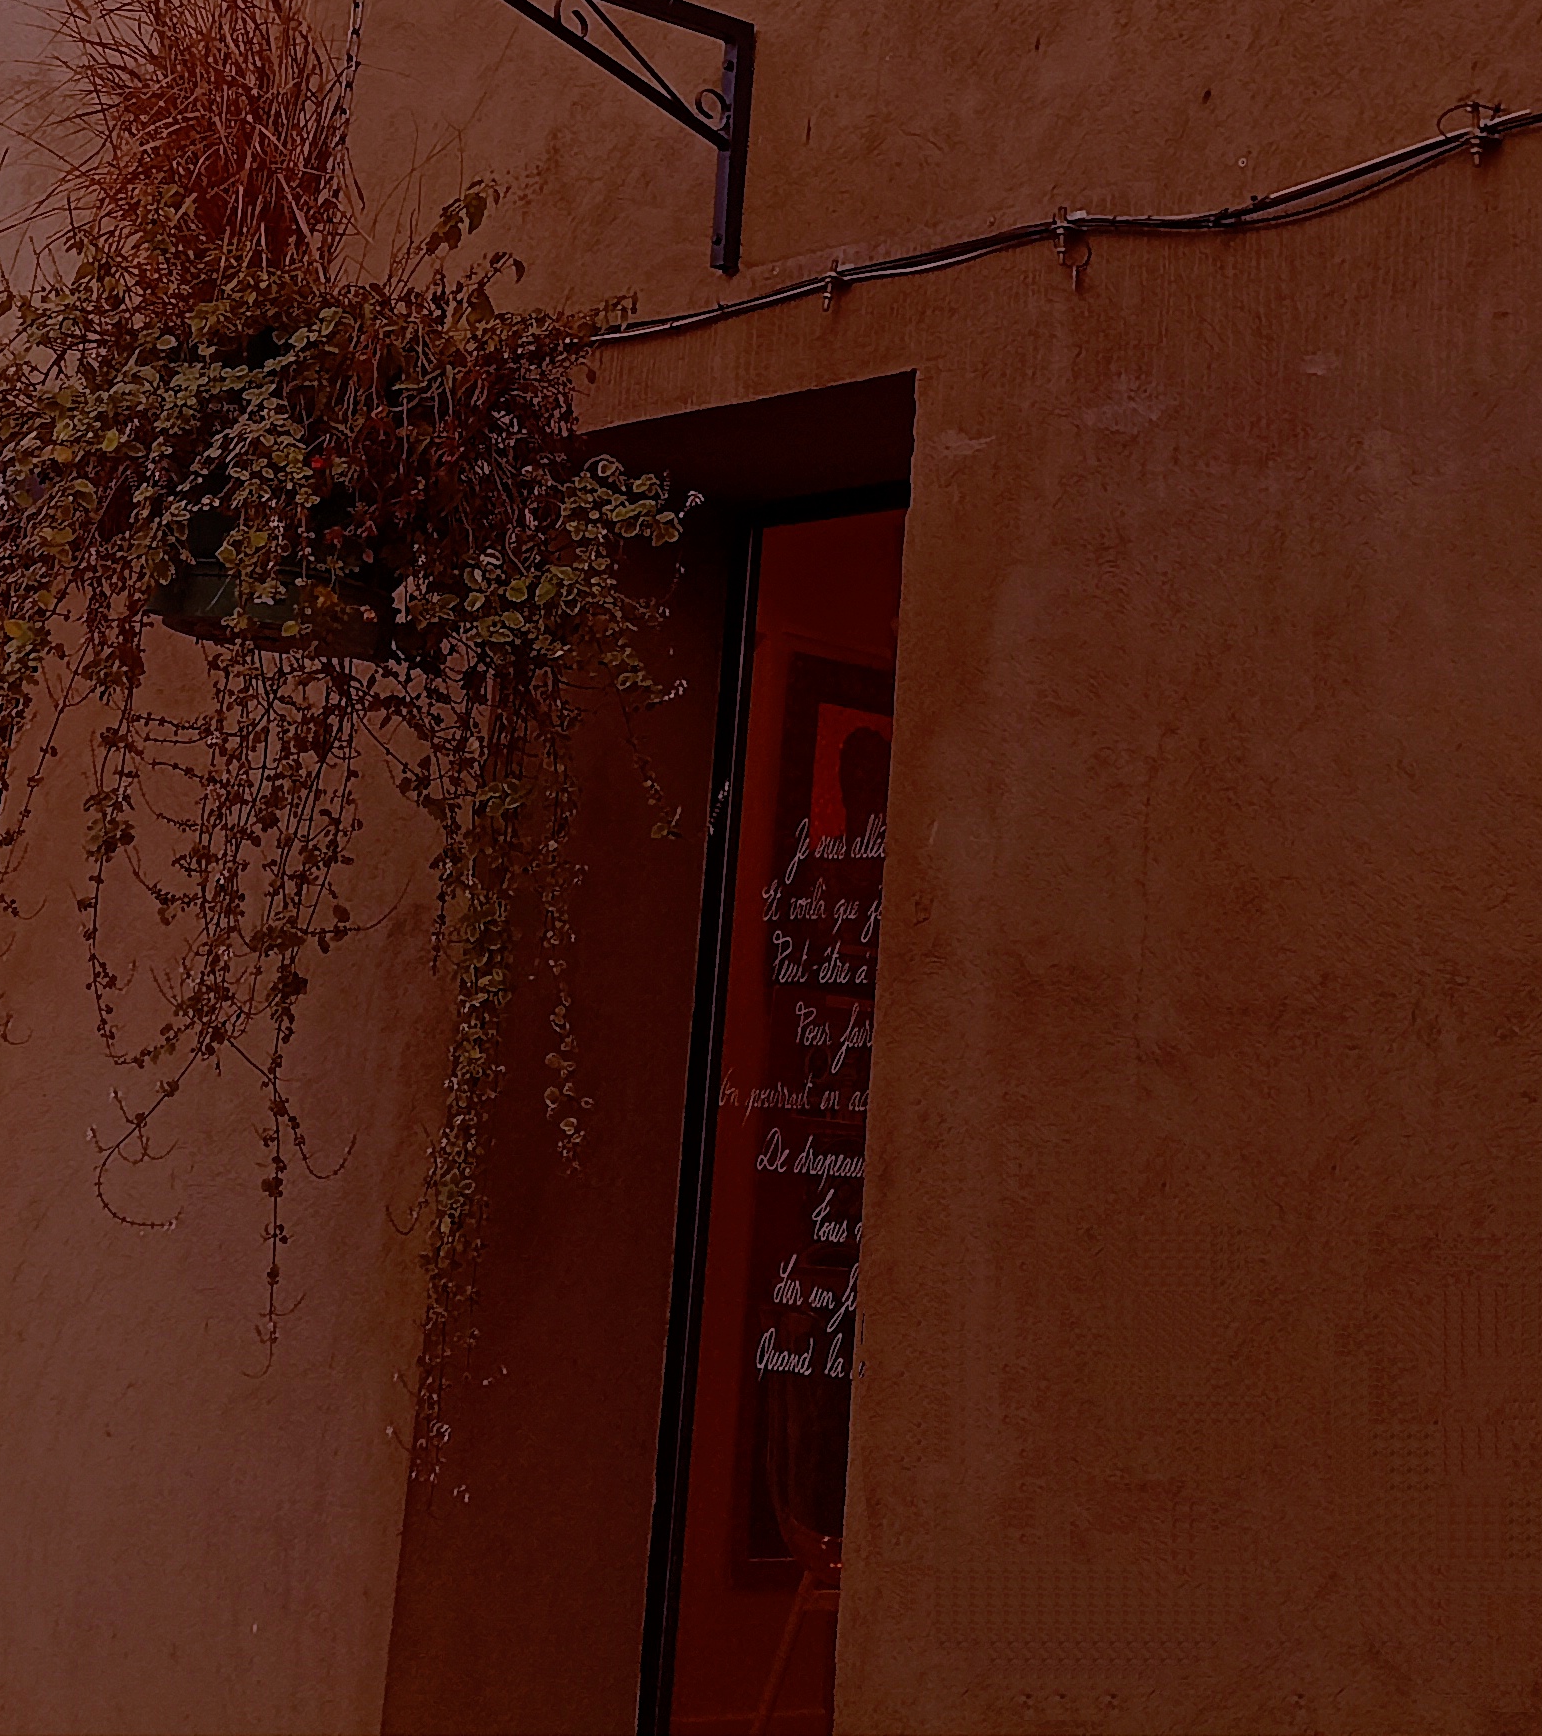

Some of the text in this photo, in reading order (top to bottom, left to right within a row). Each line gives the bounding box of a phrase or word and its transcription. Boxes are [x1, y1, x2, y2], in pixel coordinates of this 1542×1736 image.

[785, 817, 810, 884] Je
[789, 876, 826, 921] voilà
[833, 897, 859, 936] que
[796, 1001, 832, 1046] Pour
[757, 1127, 790, 1173] De
[756, 1327, 846, 1383] Quand la
